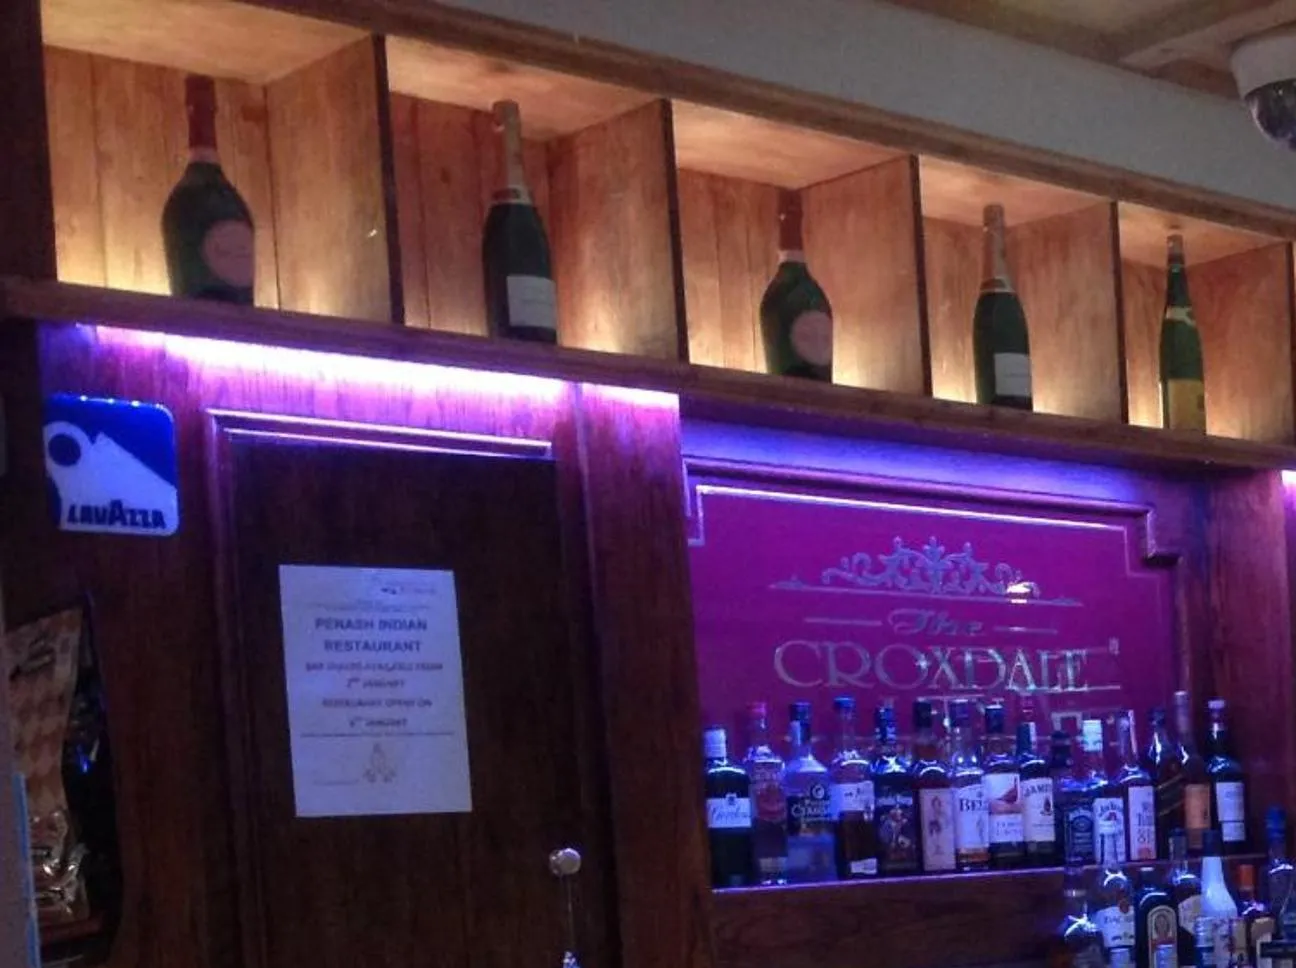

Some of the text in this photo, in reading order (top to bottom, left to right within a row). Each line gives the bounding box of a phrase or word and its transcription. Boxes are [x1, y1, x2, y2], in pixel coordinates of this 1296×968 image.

[67, 499, 167, 529] LAVAZZA
[887, 608, 985, 636] The
[324, 639, 422, 653] RESTAURANT
[773, 639, 1089, 691] CROXDALE
